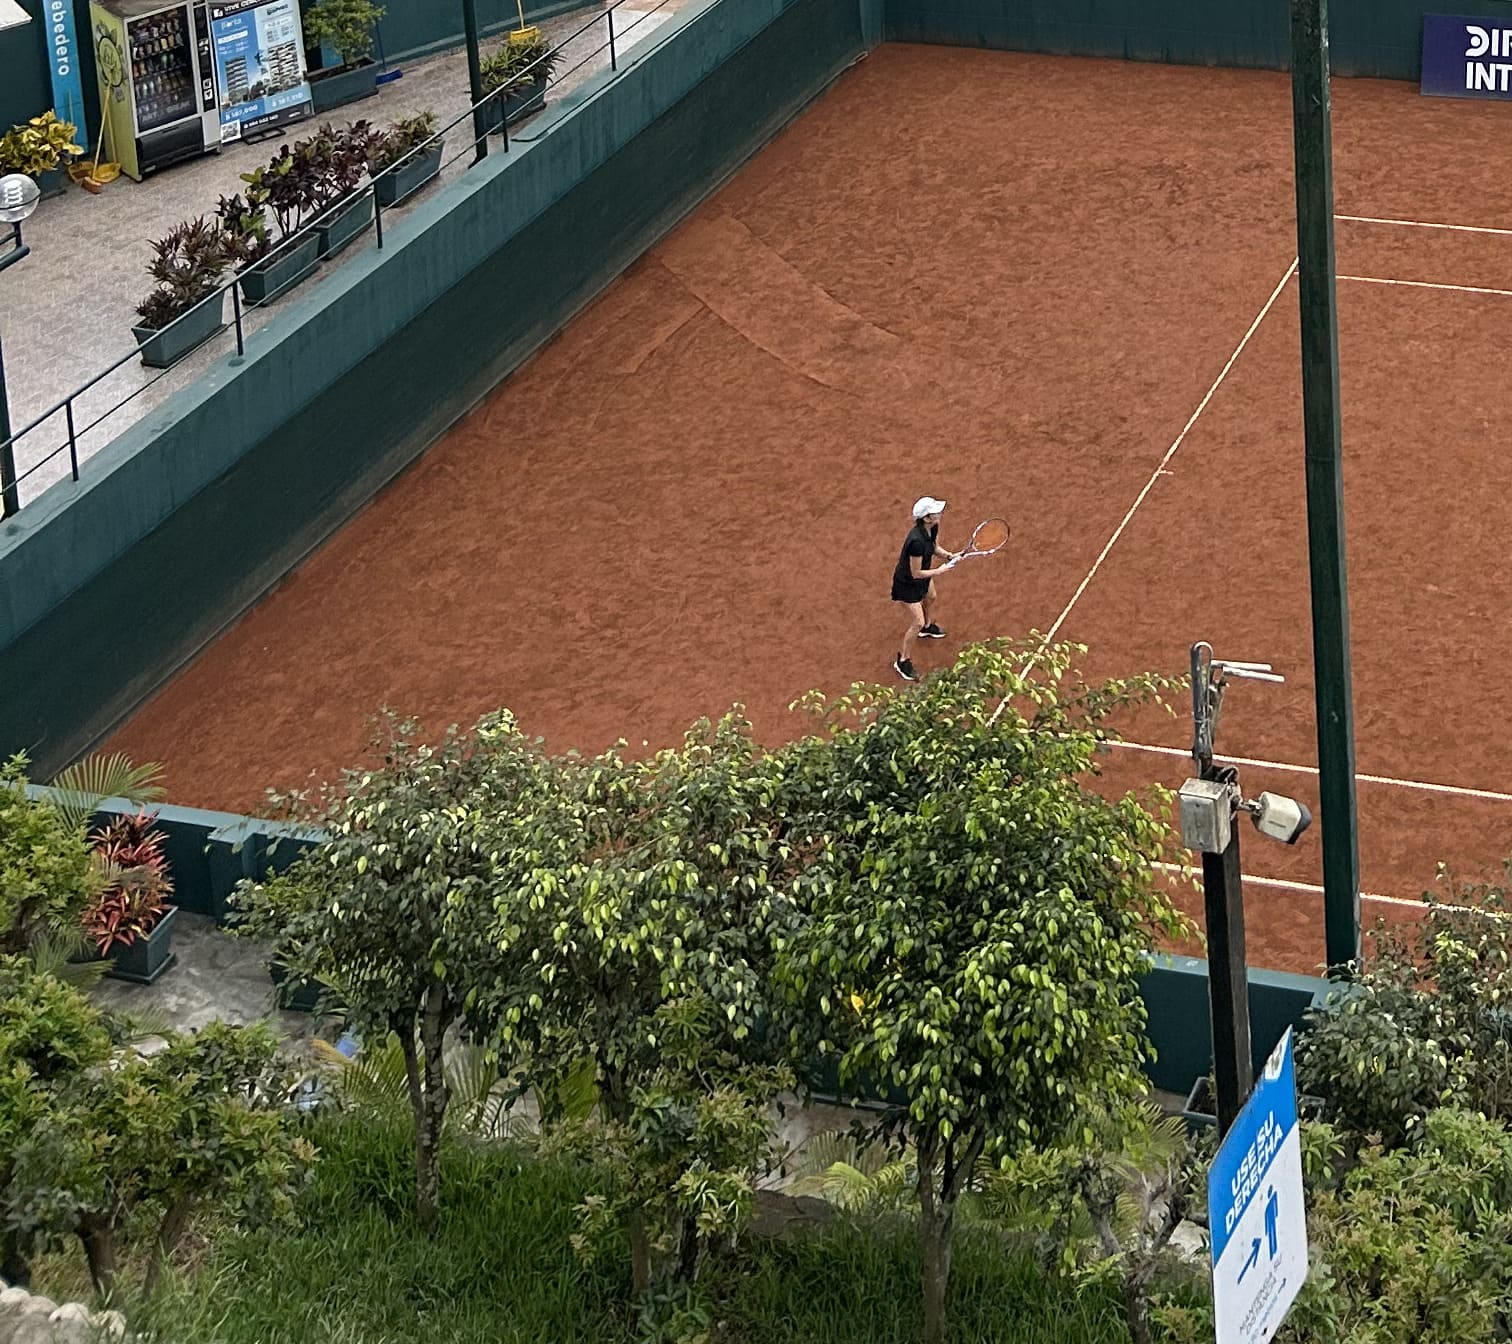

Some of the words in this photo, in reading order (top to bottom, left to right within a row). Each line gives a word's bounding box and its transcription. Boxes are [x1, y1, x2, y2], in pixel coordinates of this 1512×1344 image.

[1225, 1123, 1283, 1235] DERECHA
[1231, 1141, 1256, 1197] USE
[1257, 1110, 1274, 1150] SU
